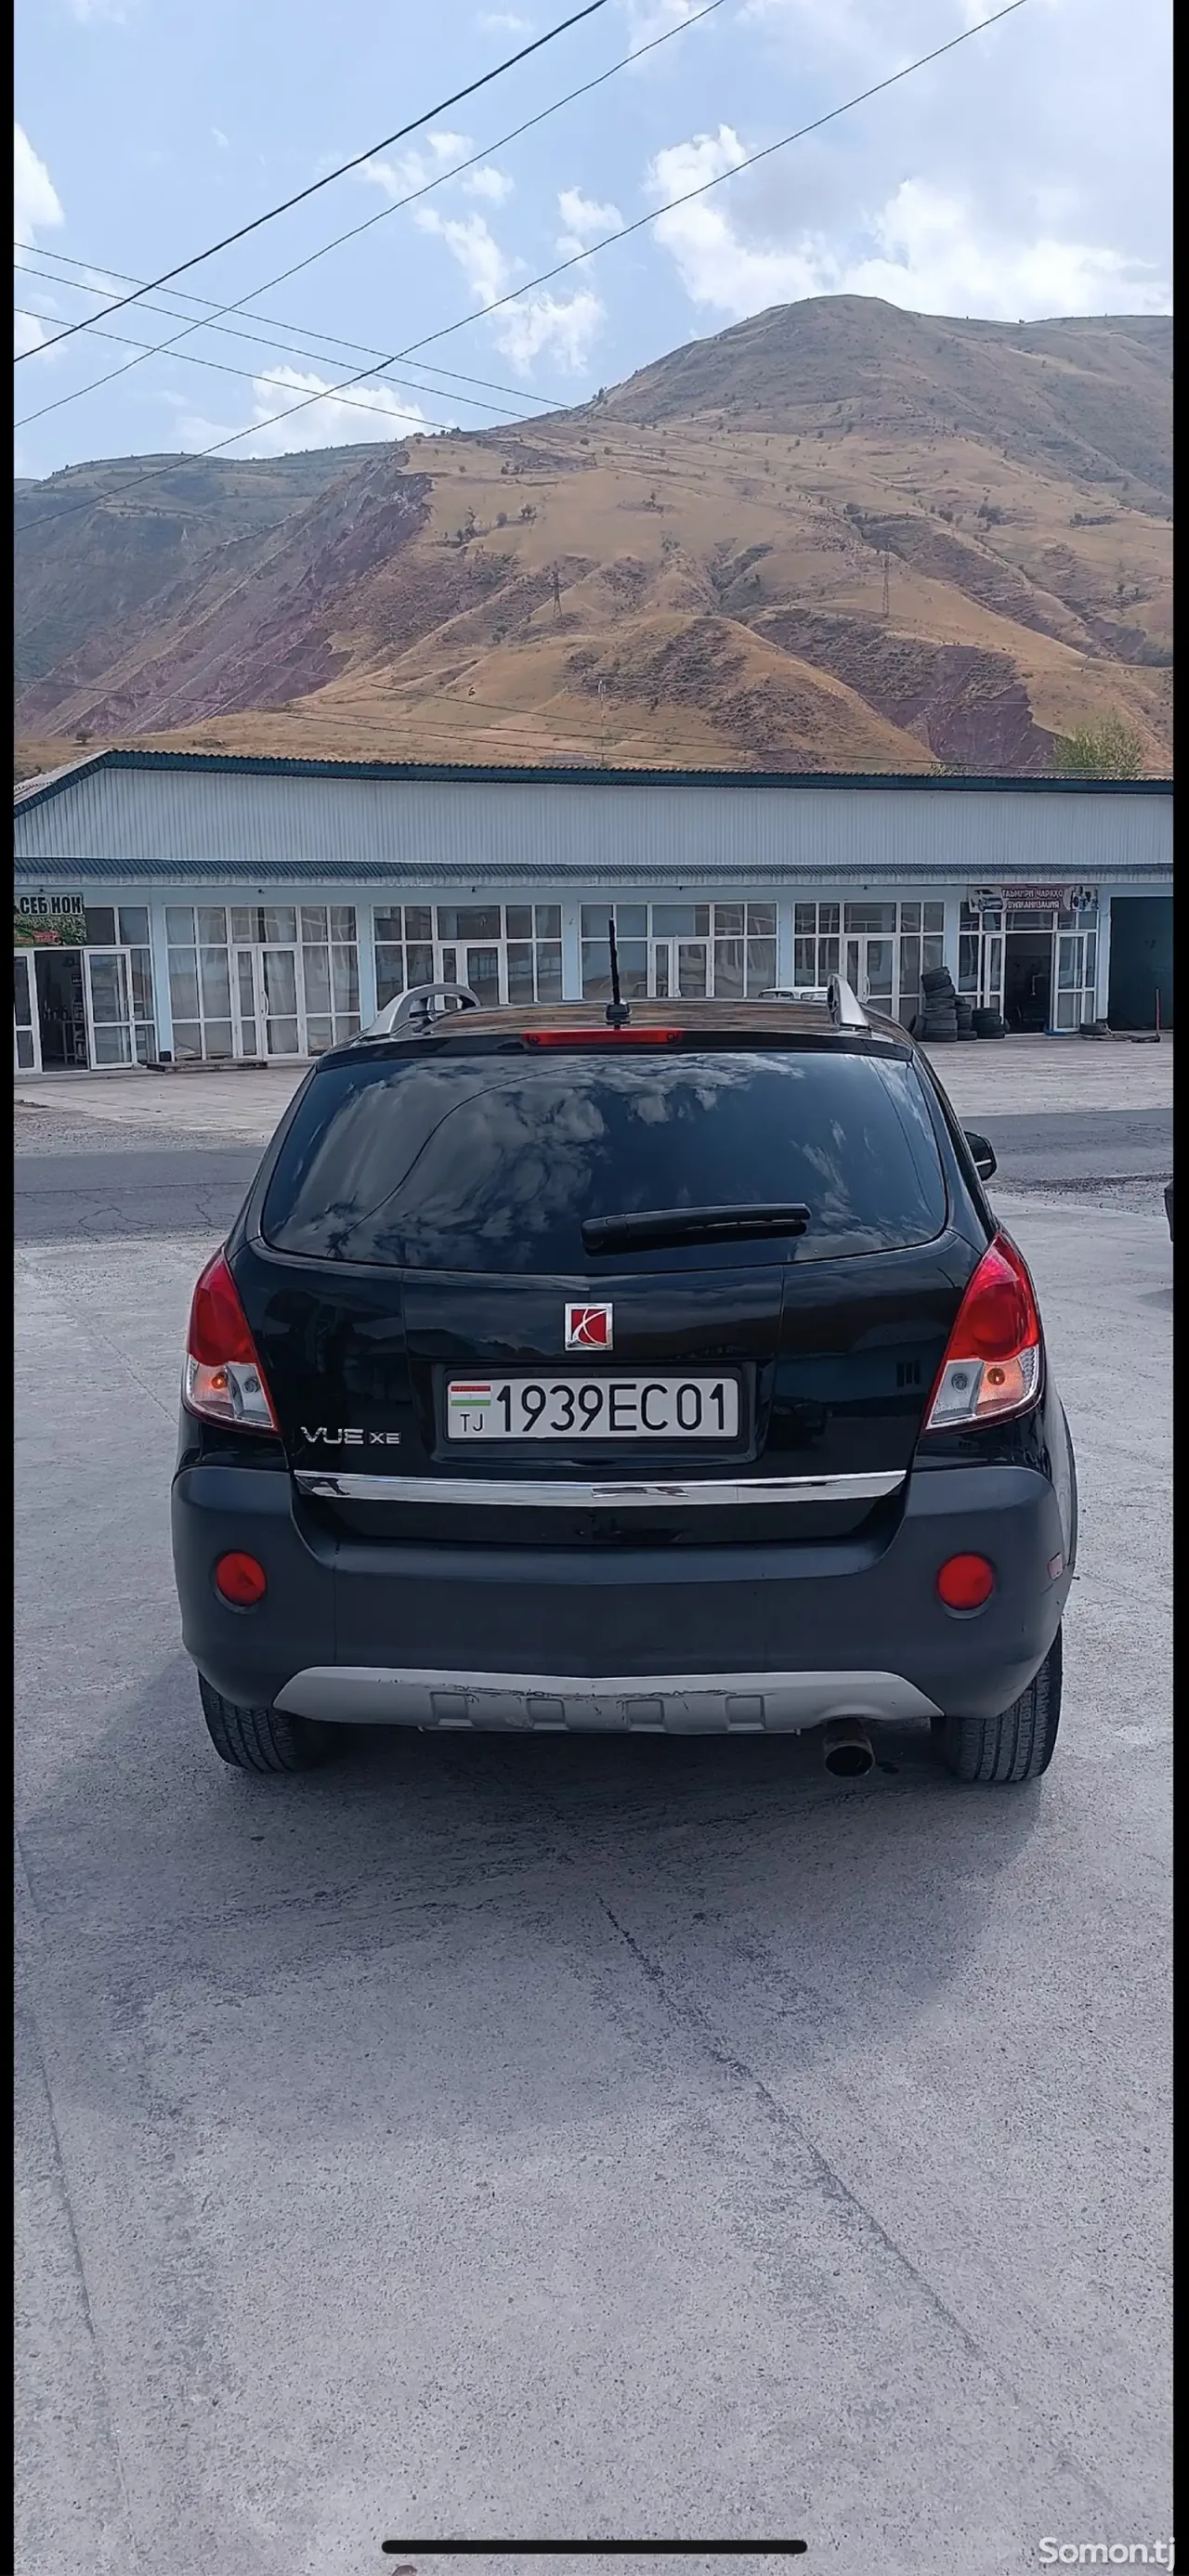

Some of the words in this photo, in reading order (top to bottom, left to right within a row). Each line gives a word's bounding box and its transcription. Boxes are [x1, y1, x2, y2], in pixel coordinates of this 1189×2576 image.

[20, 896, 48, 915] СЕБ
[50, 896, 82, 915] НОН
[460, 1413, 484, 1432] TJ
[496, 1383, 725, 1432] 1939EC01
[300, 1426, 364, 1444] VUE
[370, 1432, 400, 1444] XE
